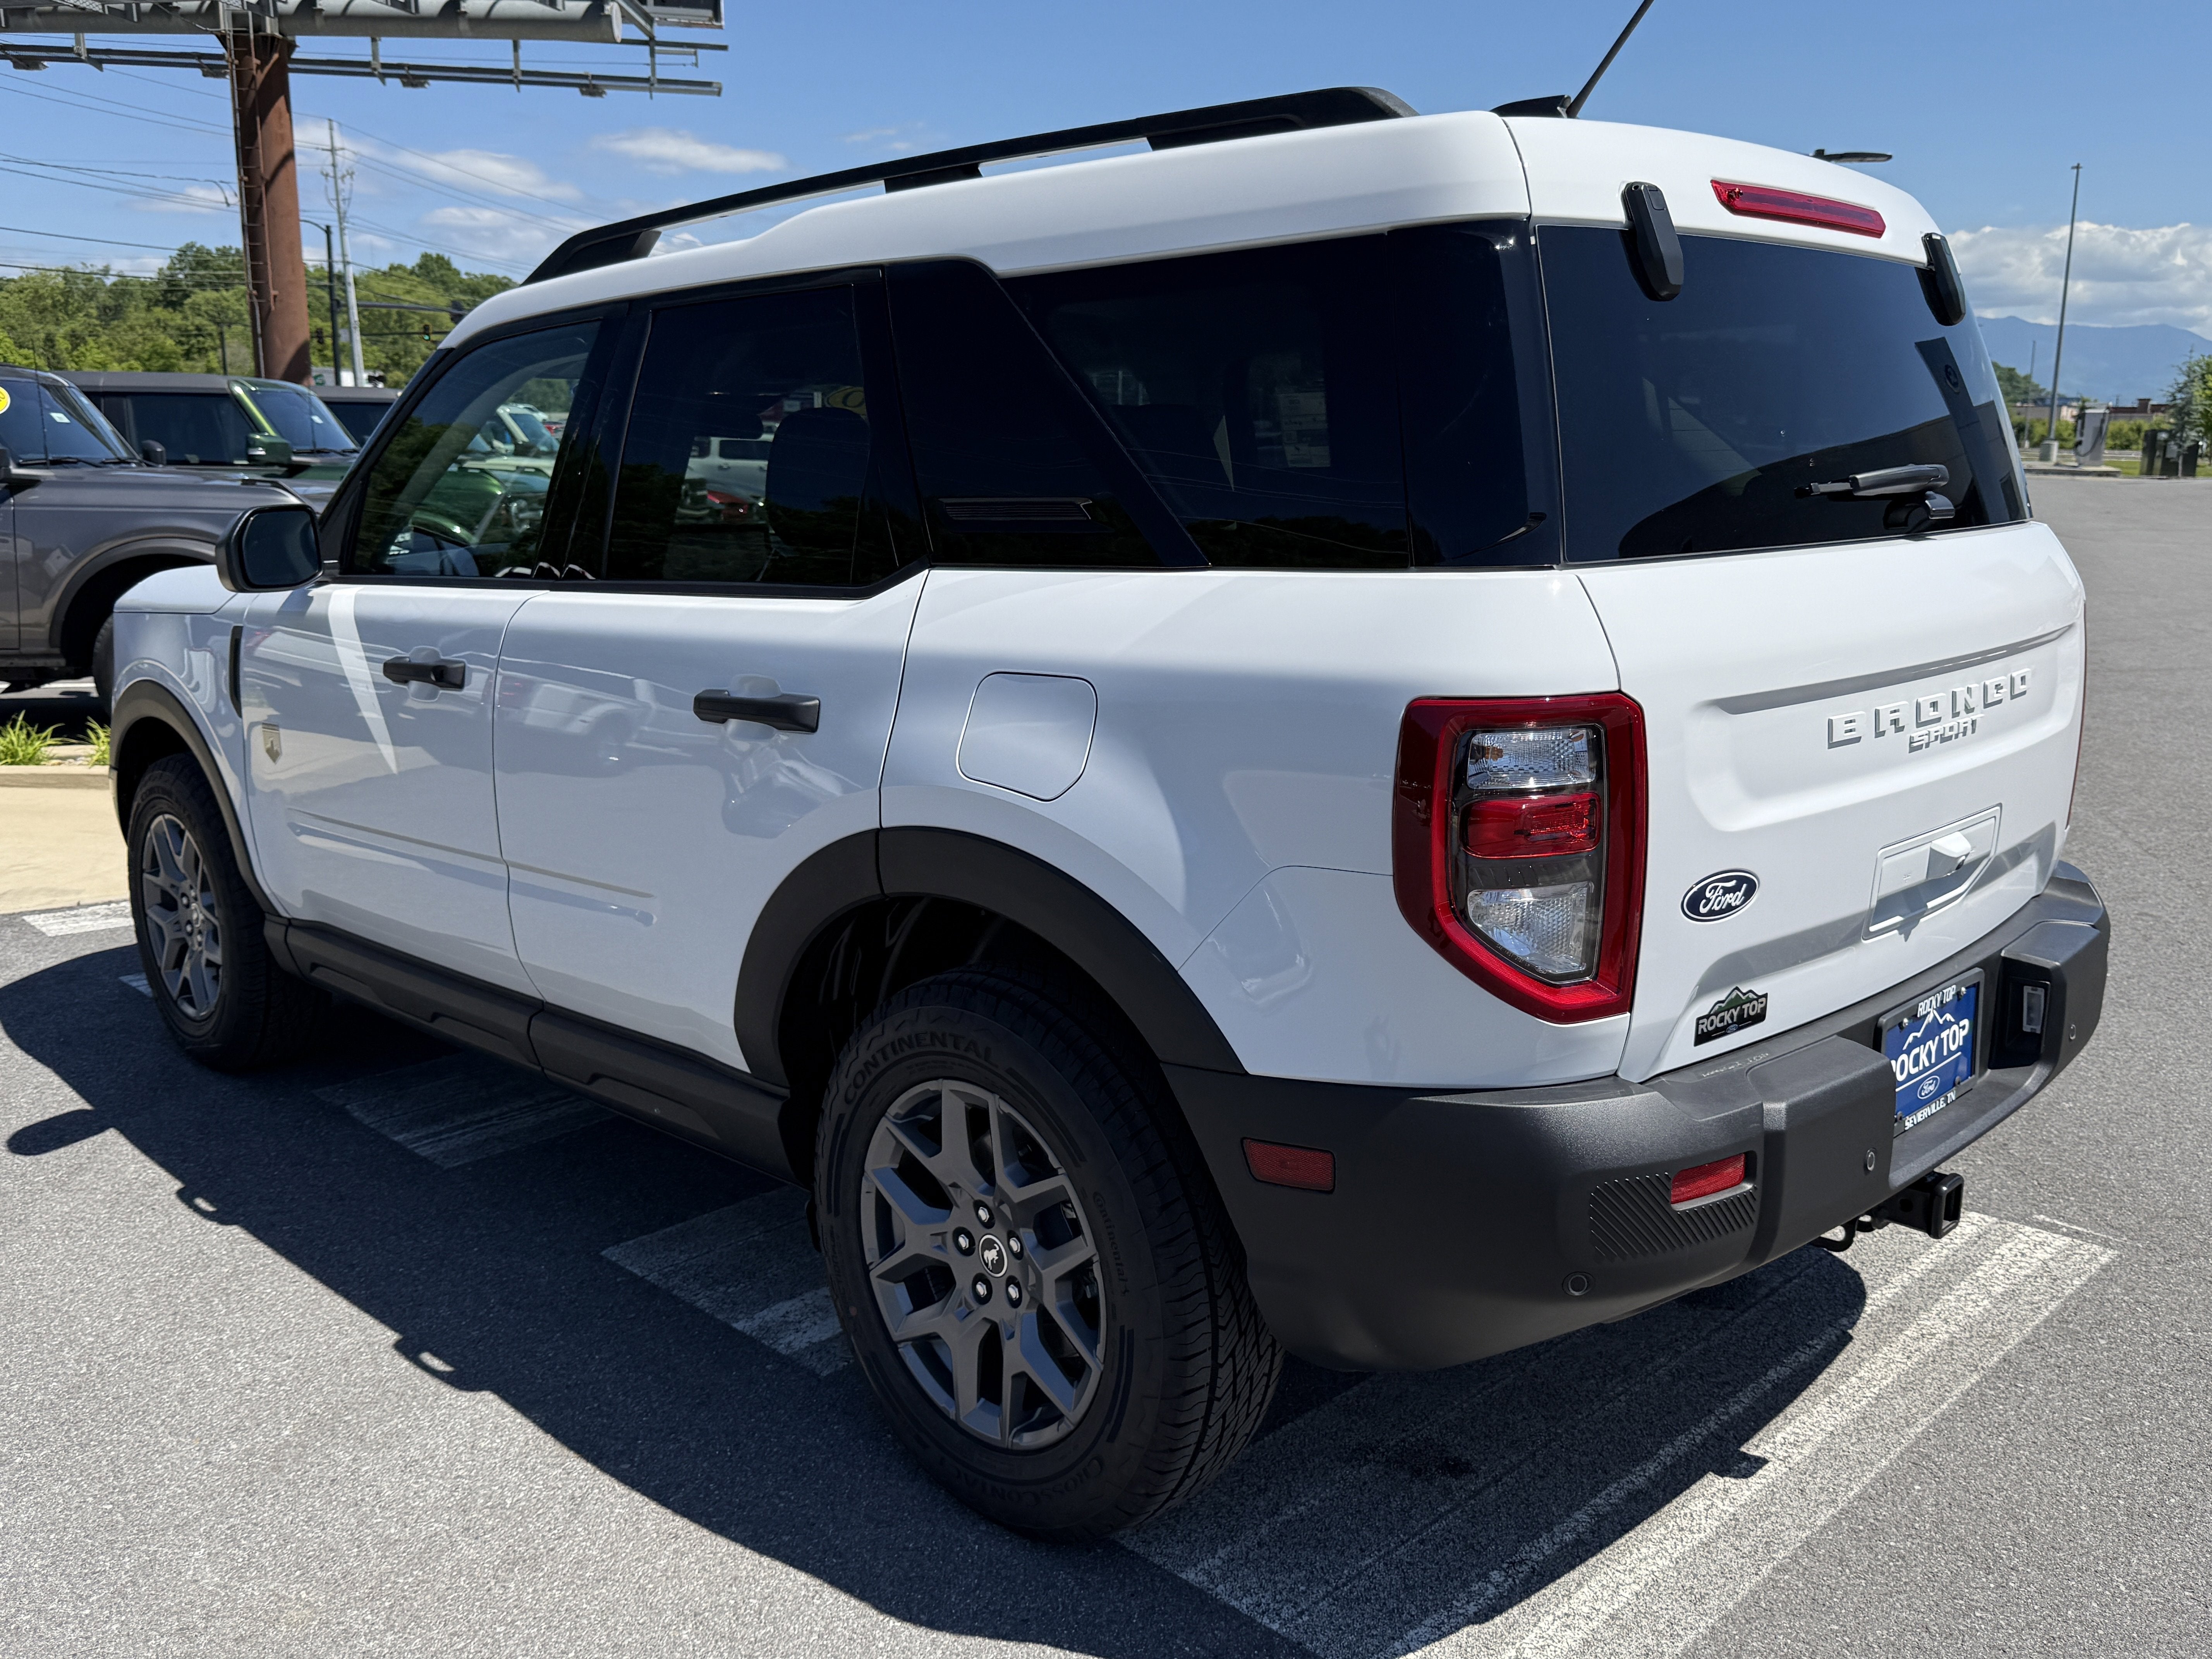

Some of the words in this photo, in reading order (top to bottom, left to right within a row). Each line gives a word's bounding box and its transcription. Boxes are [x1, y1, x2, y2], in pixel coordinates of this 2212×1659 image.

[1827, 668, 2032, 748] BRONCO
[1909, 714, 1985, 753] SPORT
[1699, 880, 1748, 914] Ford
[1698, 1006, 1741, 1035] ROCKY
[1742, 997, 1766, 1018] TOP
[1917, 991, 1942, 1018] ROCKY
[1942, 984, 1956, 1004] TOP
[1941, 1018, 1969, 1056] TOP
[844, 1030, 999, 1105] CONTINENTAL
[1921, 1079, 1936, 1096] Ford
[1946, 1089, 1956, 1104] TN
